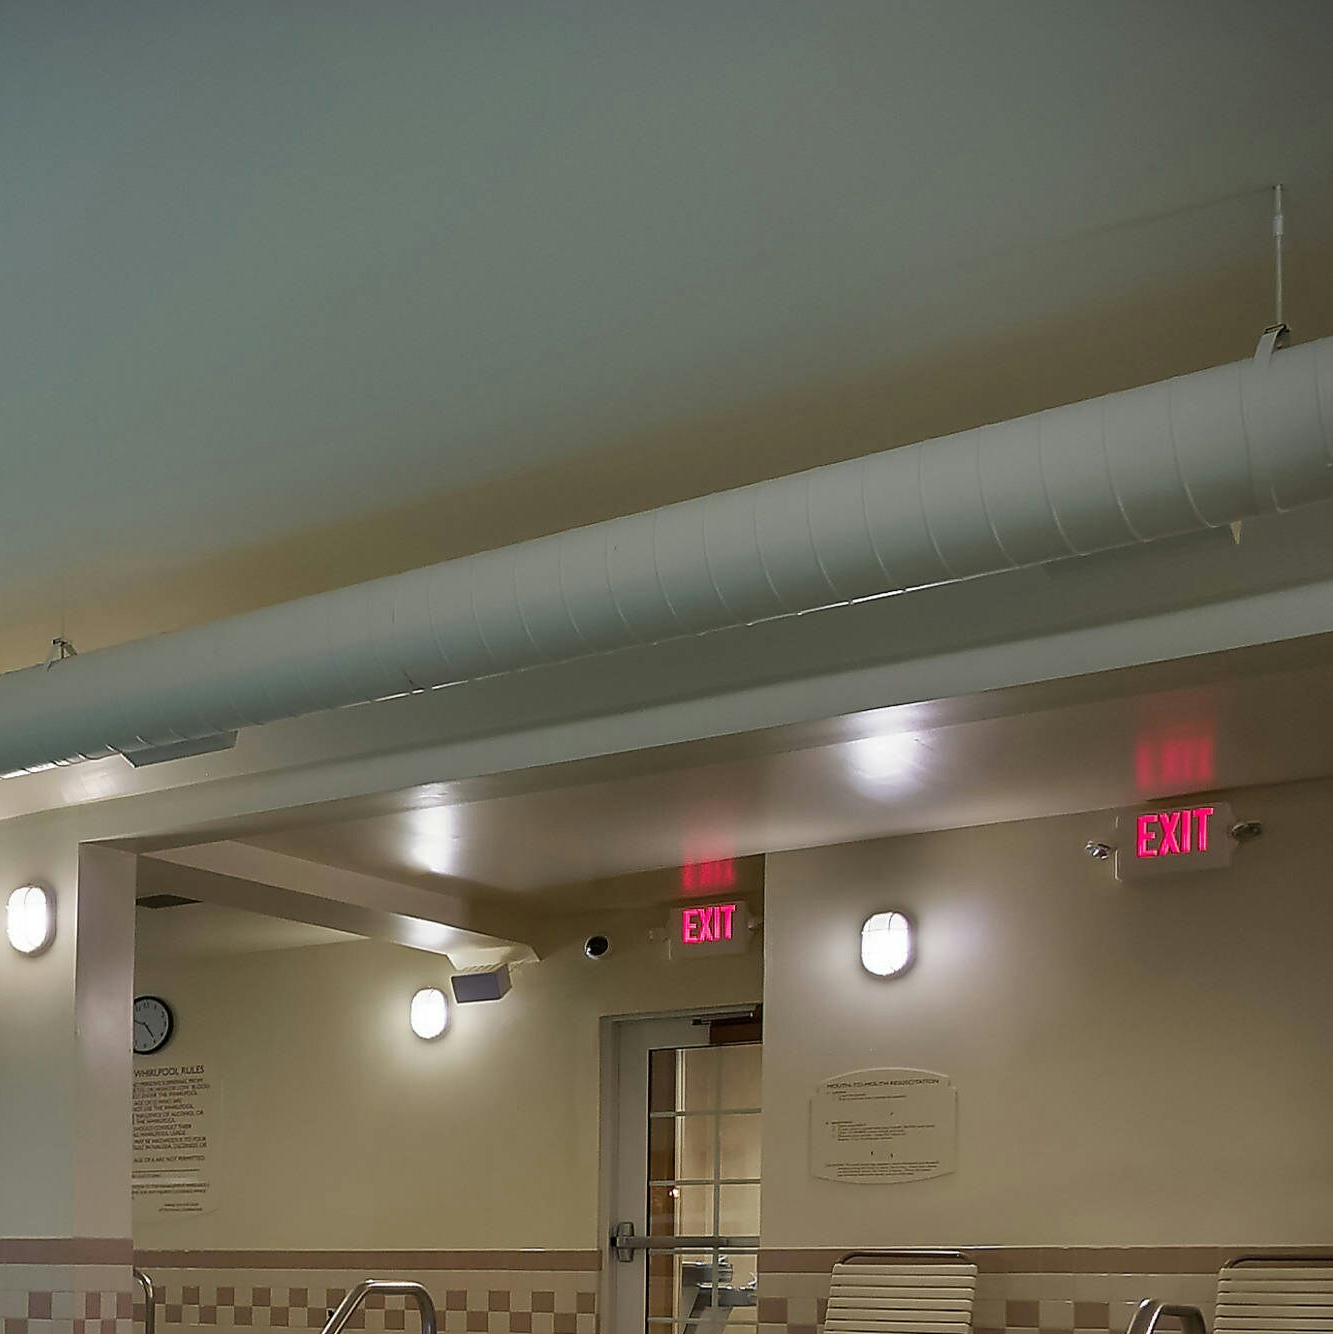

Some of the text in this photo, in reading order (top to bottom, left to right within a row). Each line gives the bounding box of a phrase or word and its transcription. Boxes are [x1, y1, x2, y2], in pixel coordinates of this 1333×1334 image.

[1136, 807, 1214, 858] EXIT
[682, 904, 736, 944] EXIT
[181, 1065, 205, 1075] RULES
